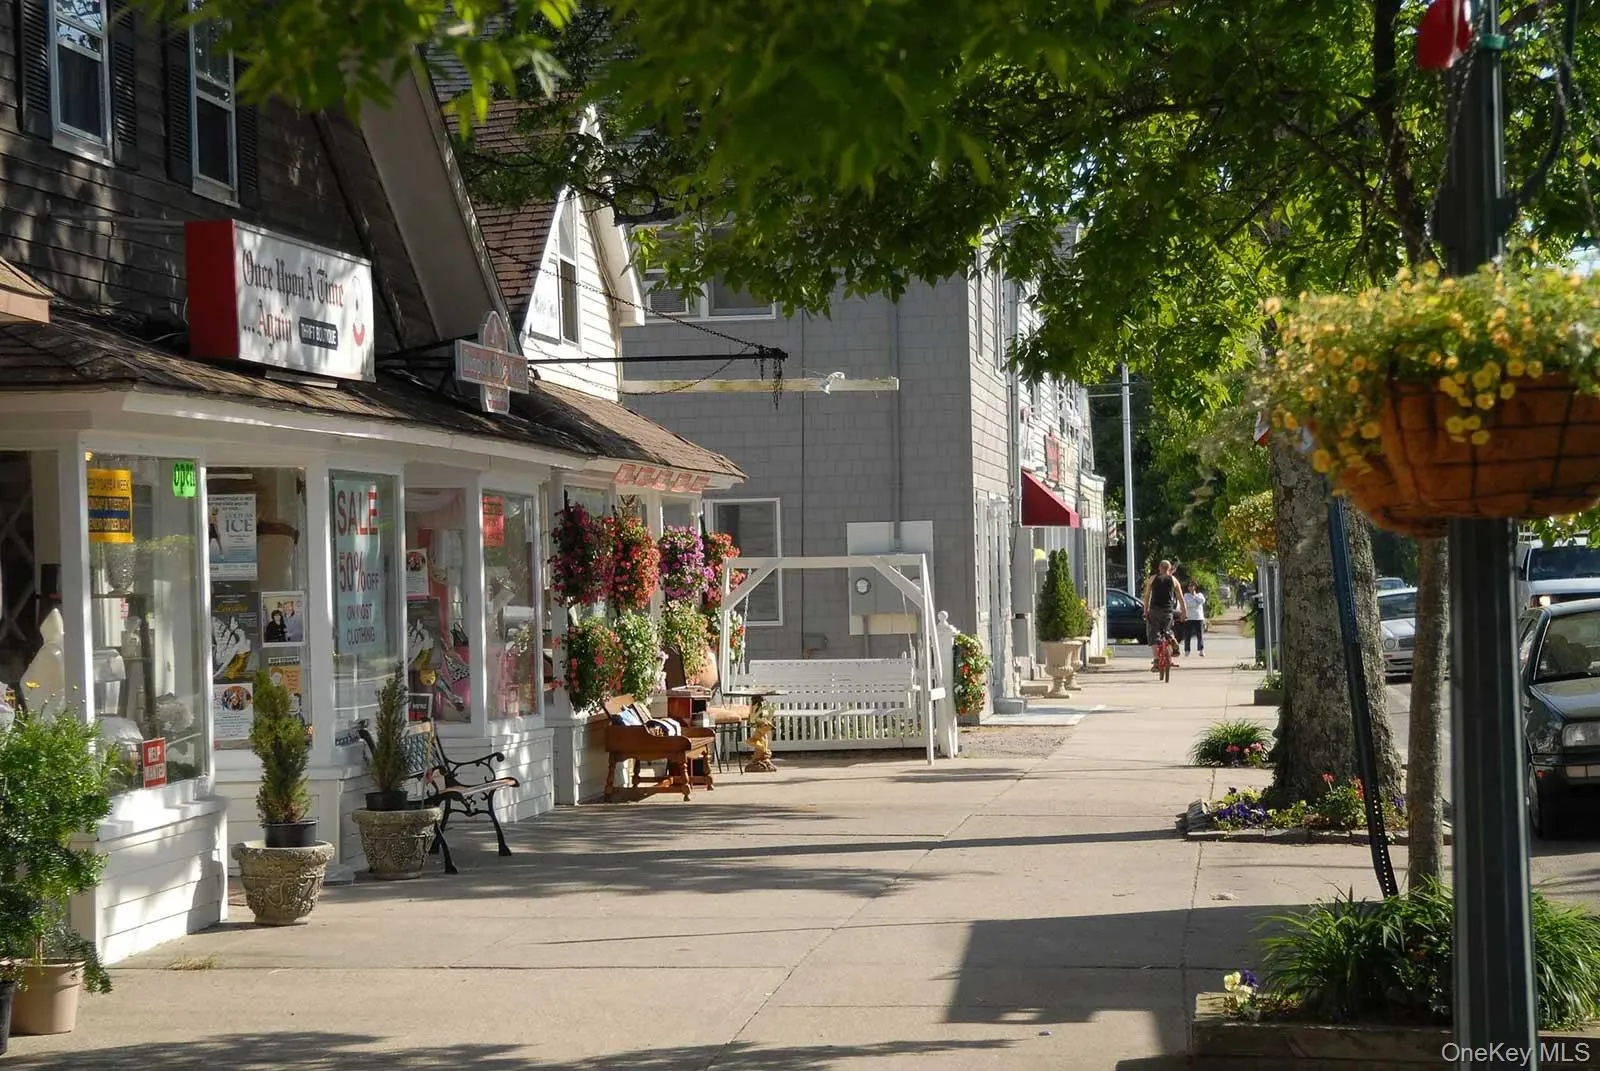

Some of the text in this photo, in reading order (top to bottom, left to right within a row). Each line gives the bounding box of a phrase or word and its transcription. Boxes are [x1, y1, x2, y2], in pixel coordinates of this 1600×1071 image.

[242, 248, 344, 307] Once Upon A Time
[225, 519, 254, 533] ICE
[337, 490, 378, 536] SALE
[339, 551, 366, 593] 50%
[366, 573, 379, 592] OFF
[347, 627, 375, 646] CLOTHING
